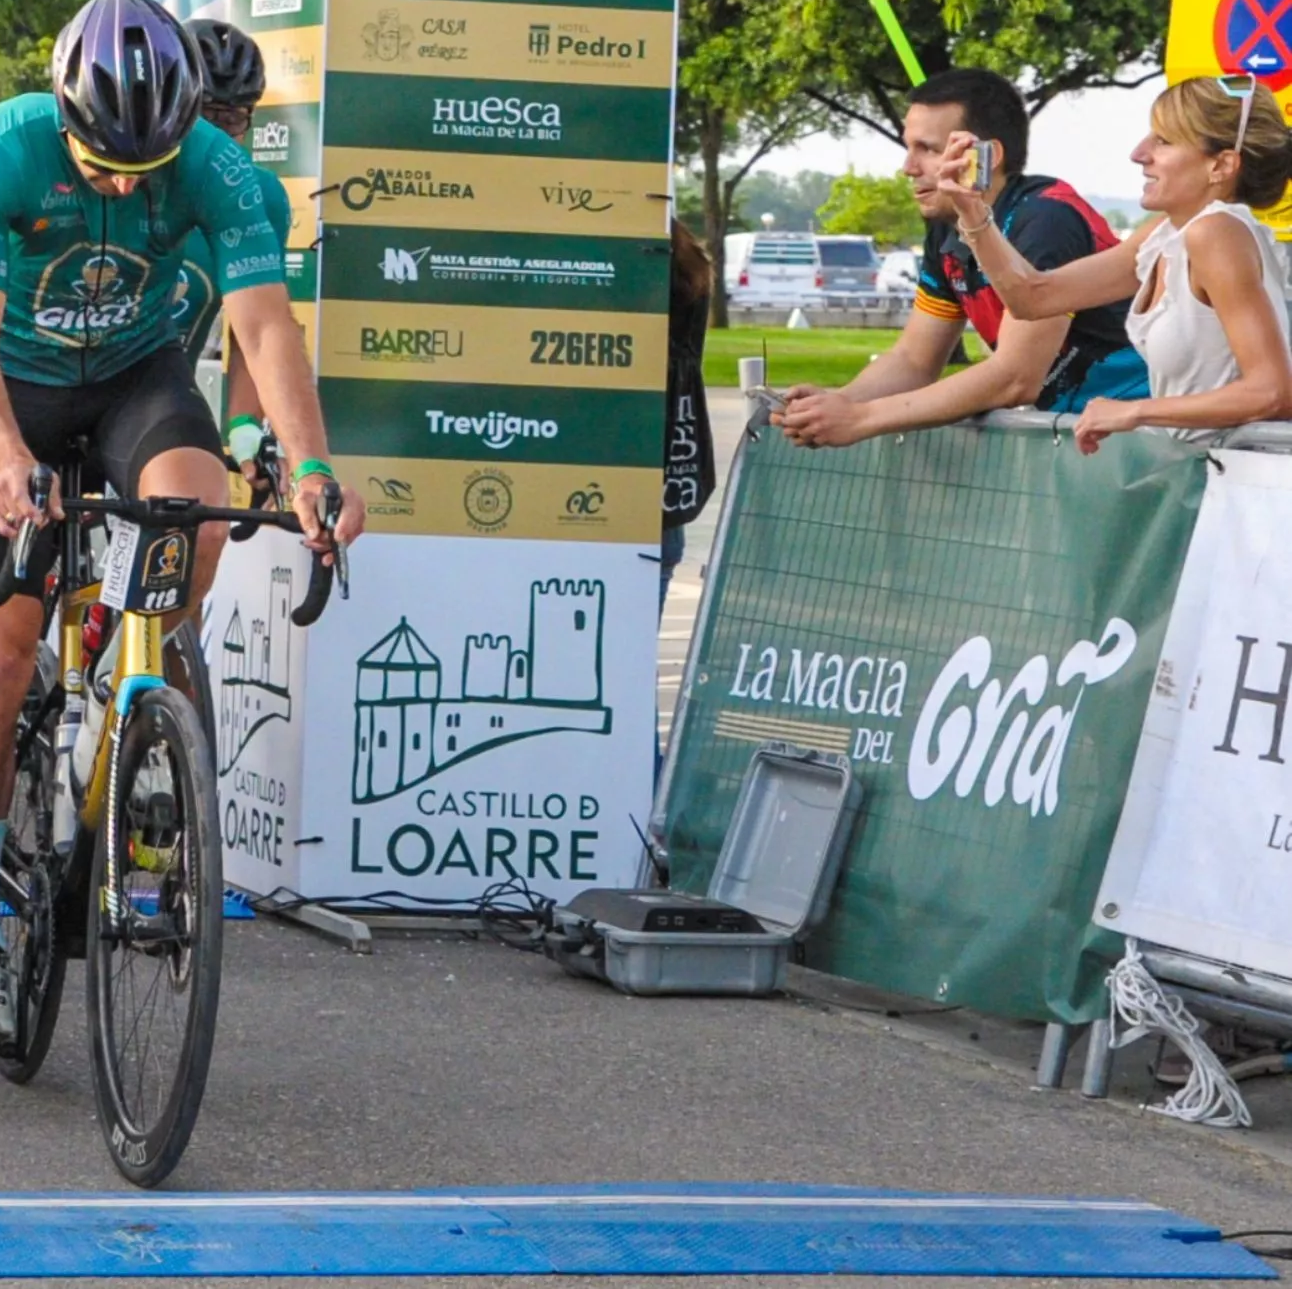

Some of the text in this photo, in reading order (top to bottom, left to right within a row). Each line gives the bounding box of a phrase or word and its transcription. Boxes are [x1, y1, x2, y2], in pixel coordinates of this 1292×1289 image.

[422, 18, 468, 36] CASA
[558, 36, 646, 59] Pedro I
[432, 96, 562, 127] Huesca
[367, 169, 432, 181] GANADOS
[540, 182, 614, 211] vive
[430, 254, 615, 272] MATA GESTIÓN ASEGURADORA
[361, 327, 463, 357] BARREU
[530, 330, 633, 367] 226ERS
[426, 410, 558, 441] Trevijano
[234, 767, 276, 804] CASTILLO
[416, 789, 567, 820] CASTILLO
[352, 817, 599, 880] LOARRE
